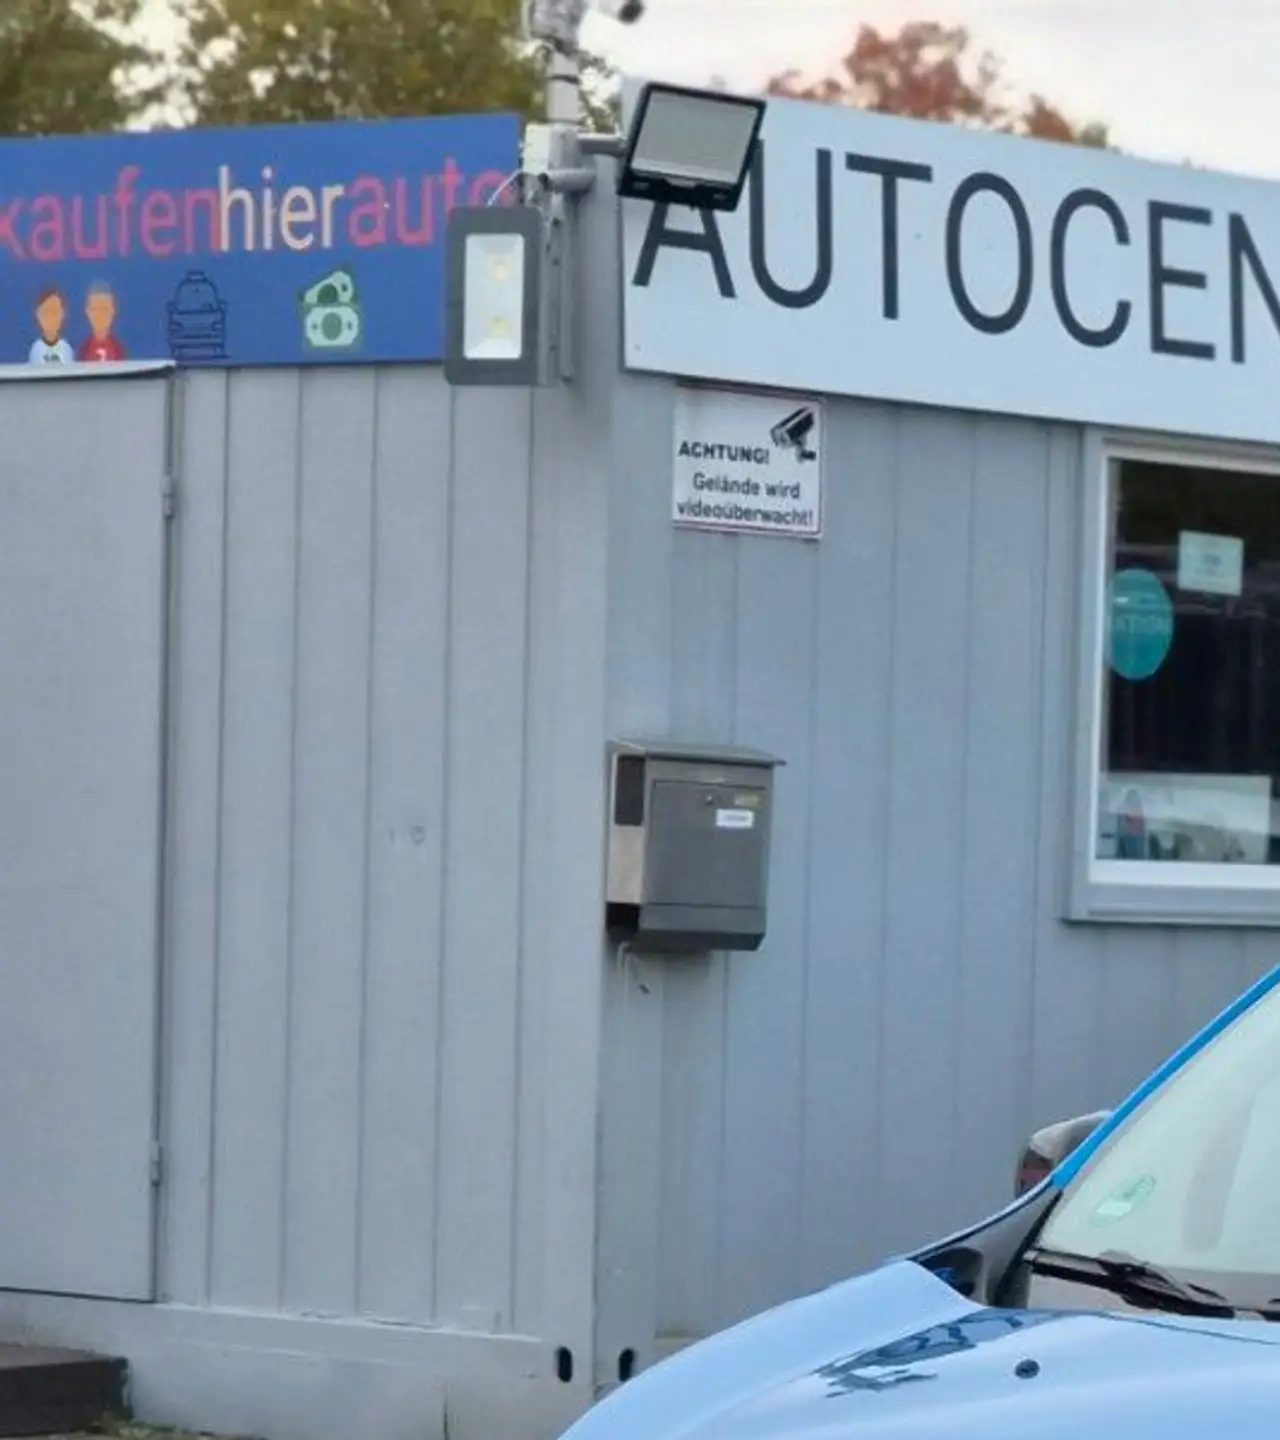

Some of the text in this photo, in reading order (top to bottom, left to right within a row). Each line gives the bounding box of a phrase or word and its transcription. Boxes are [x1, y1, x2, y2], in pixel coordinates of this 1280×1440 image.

[678, 440, 770, 465] ACHTUNG!
[692, 471, 801, 500] Gelände wird
